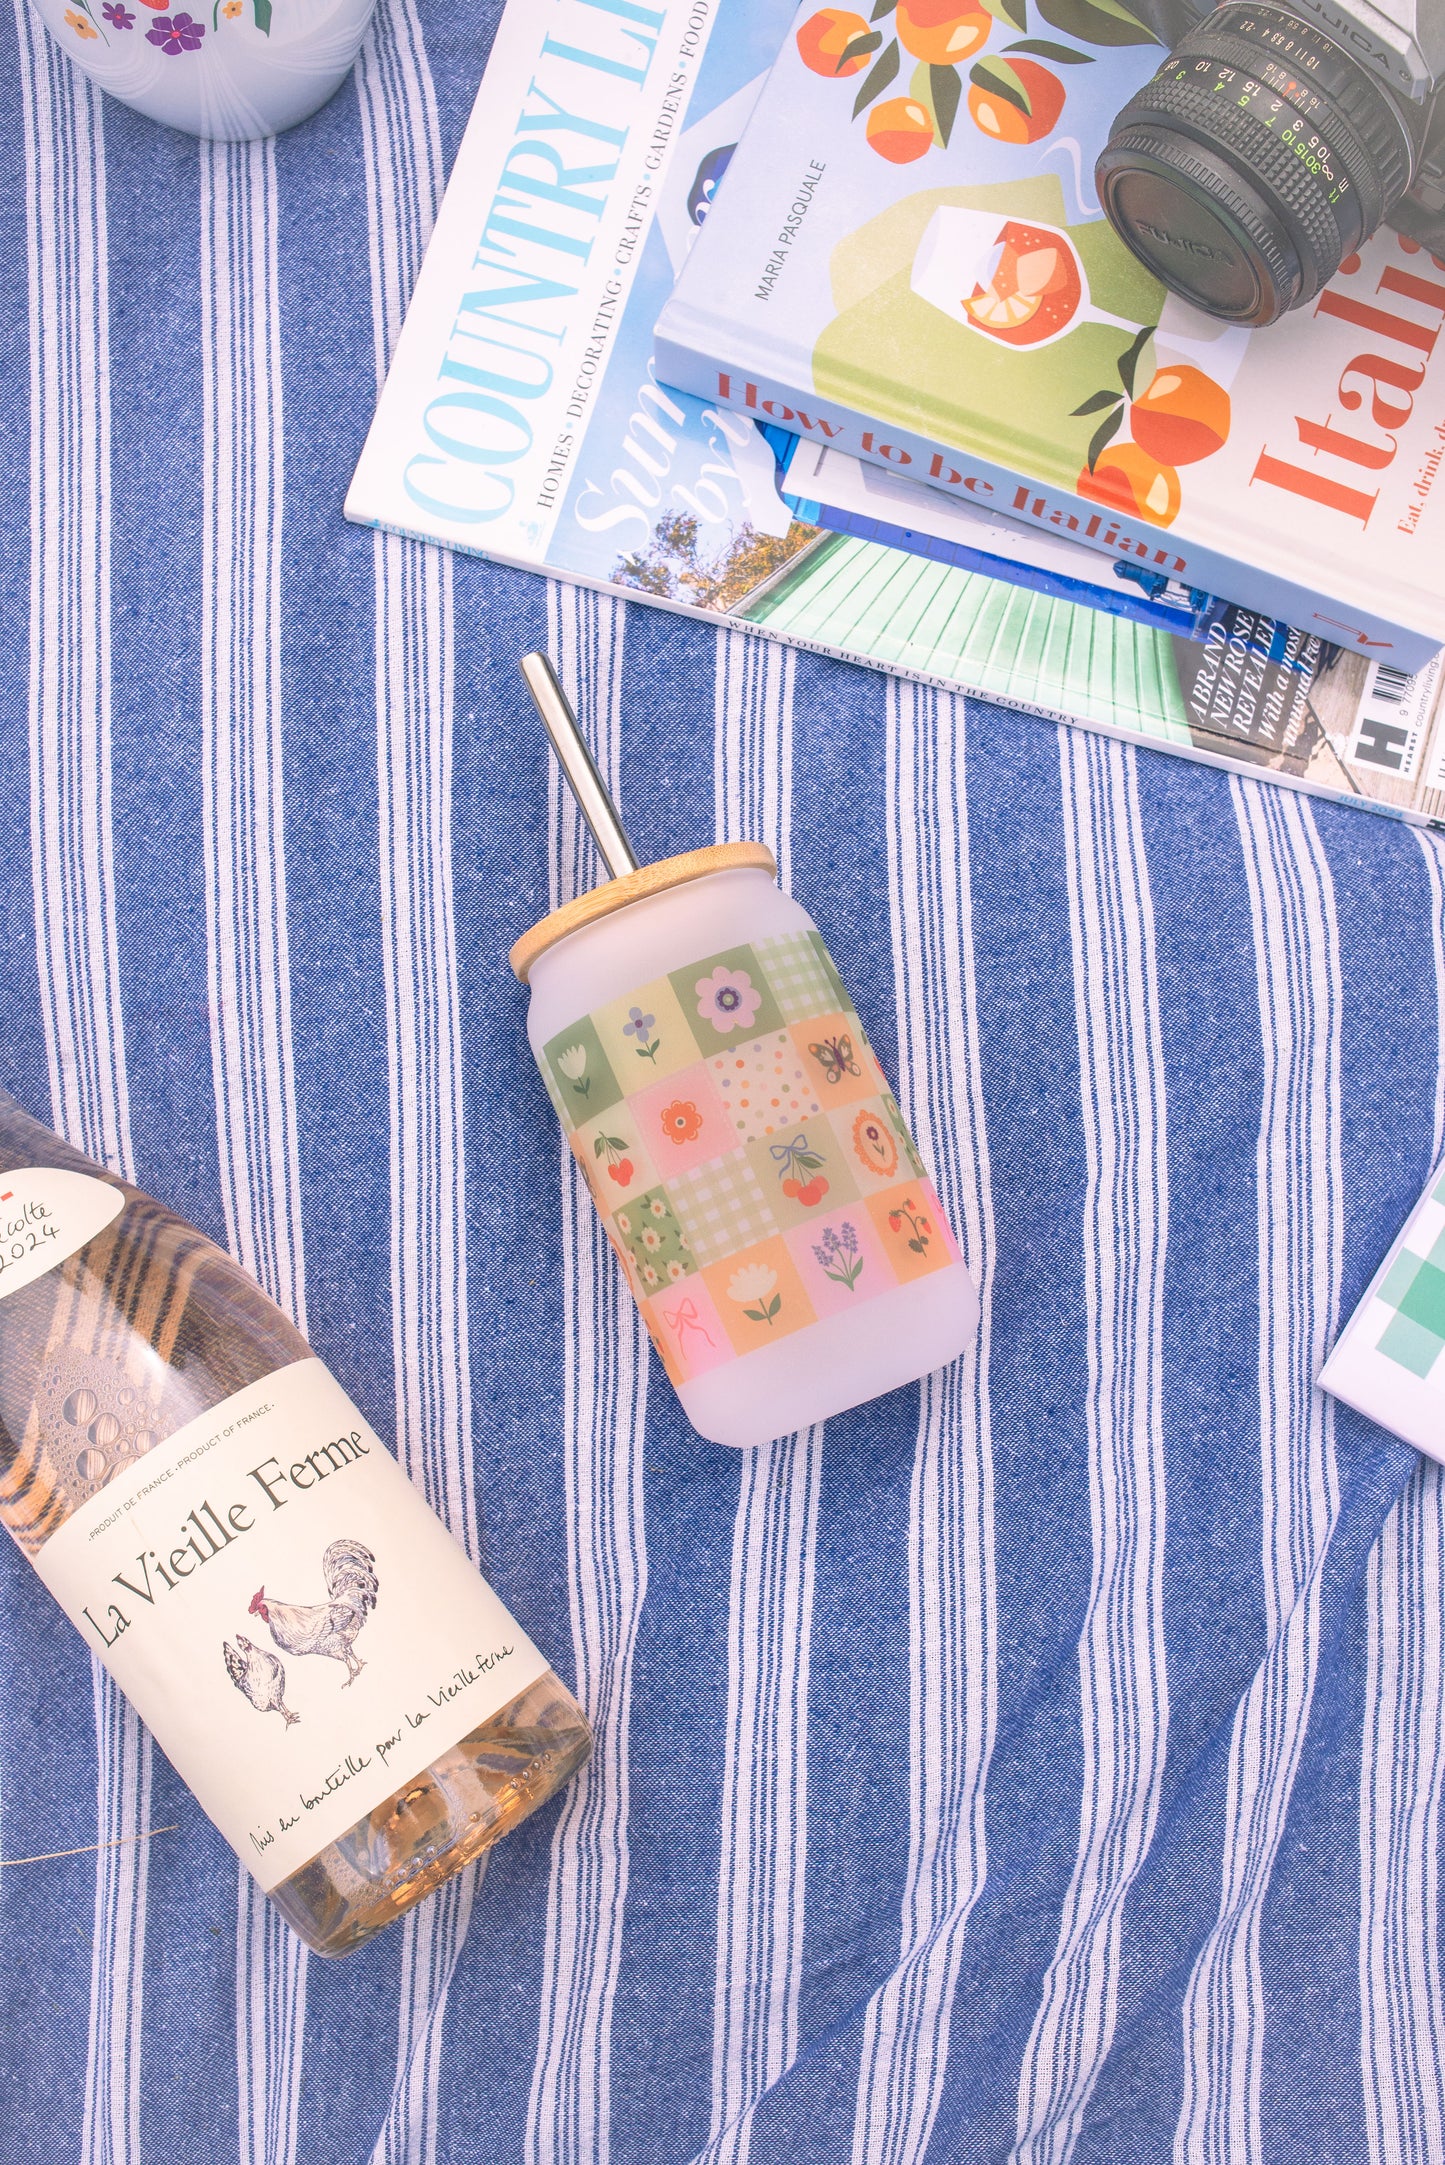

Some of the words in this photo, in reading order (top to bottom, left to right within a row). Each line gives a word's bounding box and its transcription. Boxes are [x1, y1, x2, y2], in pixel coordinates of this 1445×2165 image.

[1175, 70, 1187, 80] 3
[1195, 61, 1212, 72] 1.0
[1218, 68, 1236, 82] 1.2
[1213, 81, 1226, 92] 4
[1237, 95, 1250, 107] 5
[1242, 81, 1261, 97] 1.5
[1270, 99, 1283, 112] 2
[1264, 116, 1277, 127] 7
[1292, 120, 1304, 132] 3
[1281, 129, 1297, 146] 10
[1294, 143, 1309, 160] 15
[1307, 136, 1319, 149] 5
[1305, 155, 1320, 174] 30
[1317, 146, 1331, 163] 10
[754, 249, 789, 301] MARIA
[778, 159, 826, 245] PASQUALE
[537, 433, 574, 509] HOMES
[566, 280, 622, 420] DECORATING
[616, 184, 653, 264] CRAFTS
[645, 72, 688, 170] GARDENS
[679, 0, 709, 58] FOOD
[403, 75, 631, 524] COUNTRY
[1249, 231, 1445, 531] Itali
[715, 370, 844, 439] How
[859, 431, 914, 466] to
[928, 453, 995, 497] be
[1009, 484, 1189, 574] Italian
[384, 522, 443, 550] COUNTRY
[442, 540, 490, 561] LIVING
[728, 620, 778, 640] WHEN
[787, 637, 832, 655] YOUR
[840, 652, 898, 673] HEART
[905, 670, 920, 680] IS
[928, 677, 947, 687] IN
[955, 684, 989, 699] THE
[996, 696, 1079, 724] COUNTRY
[1193, 622, 1227, 706] BRAND
[1210, 667, 1238, 729] NEW
[1224, 610, 1255, 677] ROSE
[1190, 701, 1207, 724] A
[1258, 691, 1286, 741] With
[1276, 674, 1289, 691] a
[1283, 659, 1315, 747] unusual
[1403, 732, 1418, 773] HEARST
[1338, 794, 1368, 809] JULY
[0, 1201, 53, 1244] colte
[90, 1508, 123, 1540] PRODUIT
[123, 1497, 138, 1511] DE
[136, 1469, 175, 1501] FRANCE
[177, 1434, 222, 1469] PRODUCT
[222, 1425, 235, 1437] OF
[236, 1404, 272, 1429] FRANCE
[82, 1604, 132, 1648] La
[111, 1500, 256, 1605] Vieille
[246, 1431, 370, 1511] Ferme
[299, 1755, 372, 1810] bouteille
[376, 1728, 402, 1767] pour
[427, 1669, 480, 1707] Vieille
